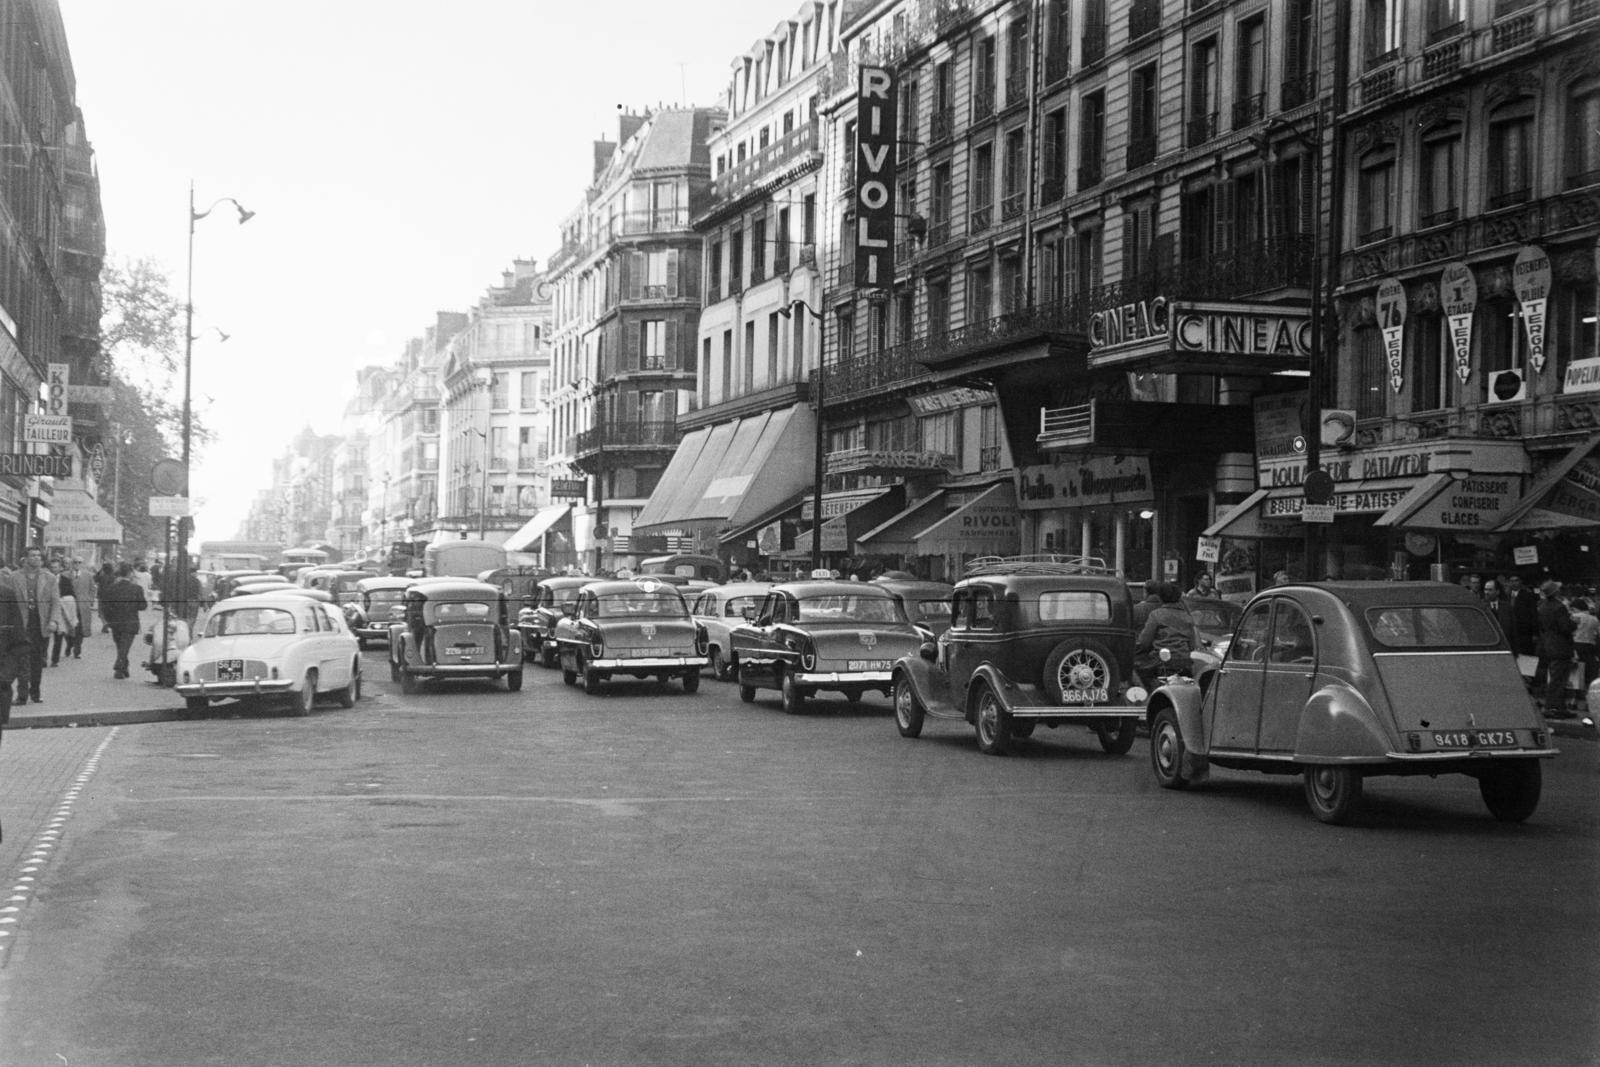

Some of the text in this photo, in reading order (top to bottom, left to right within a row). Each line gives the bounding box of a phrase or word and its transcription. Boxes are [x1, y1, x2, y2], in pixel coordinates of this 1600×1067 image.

[859, 68, 891, 284] RIVOLI
[1520, 286, 1545, 301] PLUIE
[1380, 301, 1402, 330] 76
[1526, 302, 1543, 368] TERGAL
[1452, 316, 1469, 379] TERGAL
[1385, 329, 1400, 388] TERGAL
[26, 427, 68, 441] TAILLEUR
[1461, 480, 1509, 495] PATISSERIE
[1451, 495, 1500, 511] CONFISERIE
[52, 513, 100, 522] TABAC
[963, 515, 1016, 528] RIVOLI
[1441, 511, 1480, 526] GLACES
[1434, 731, 1515, 746] 9418 GK75
